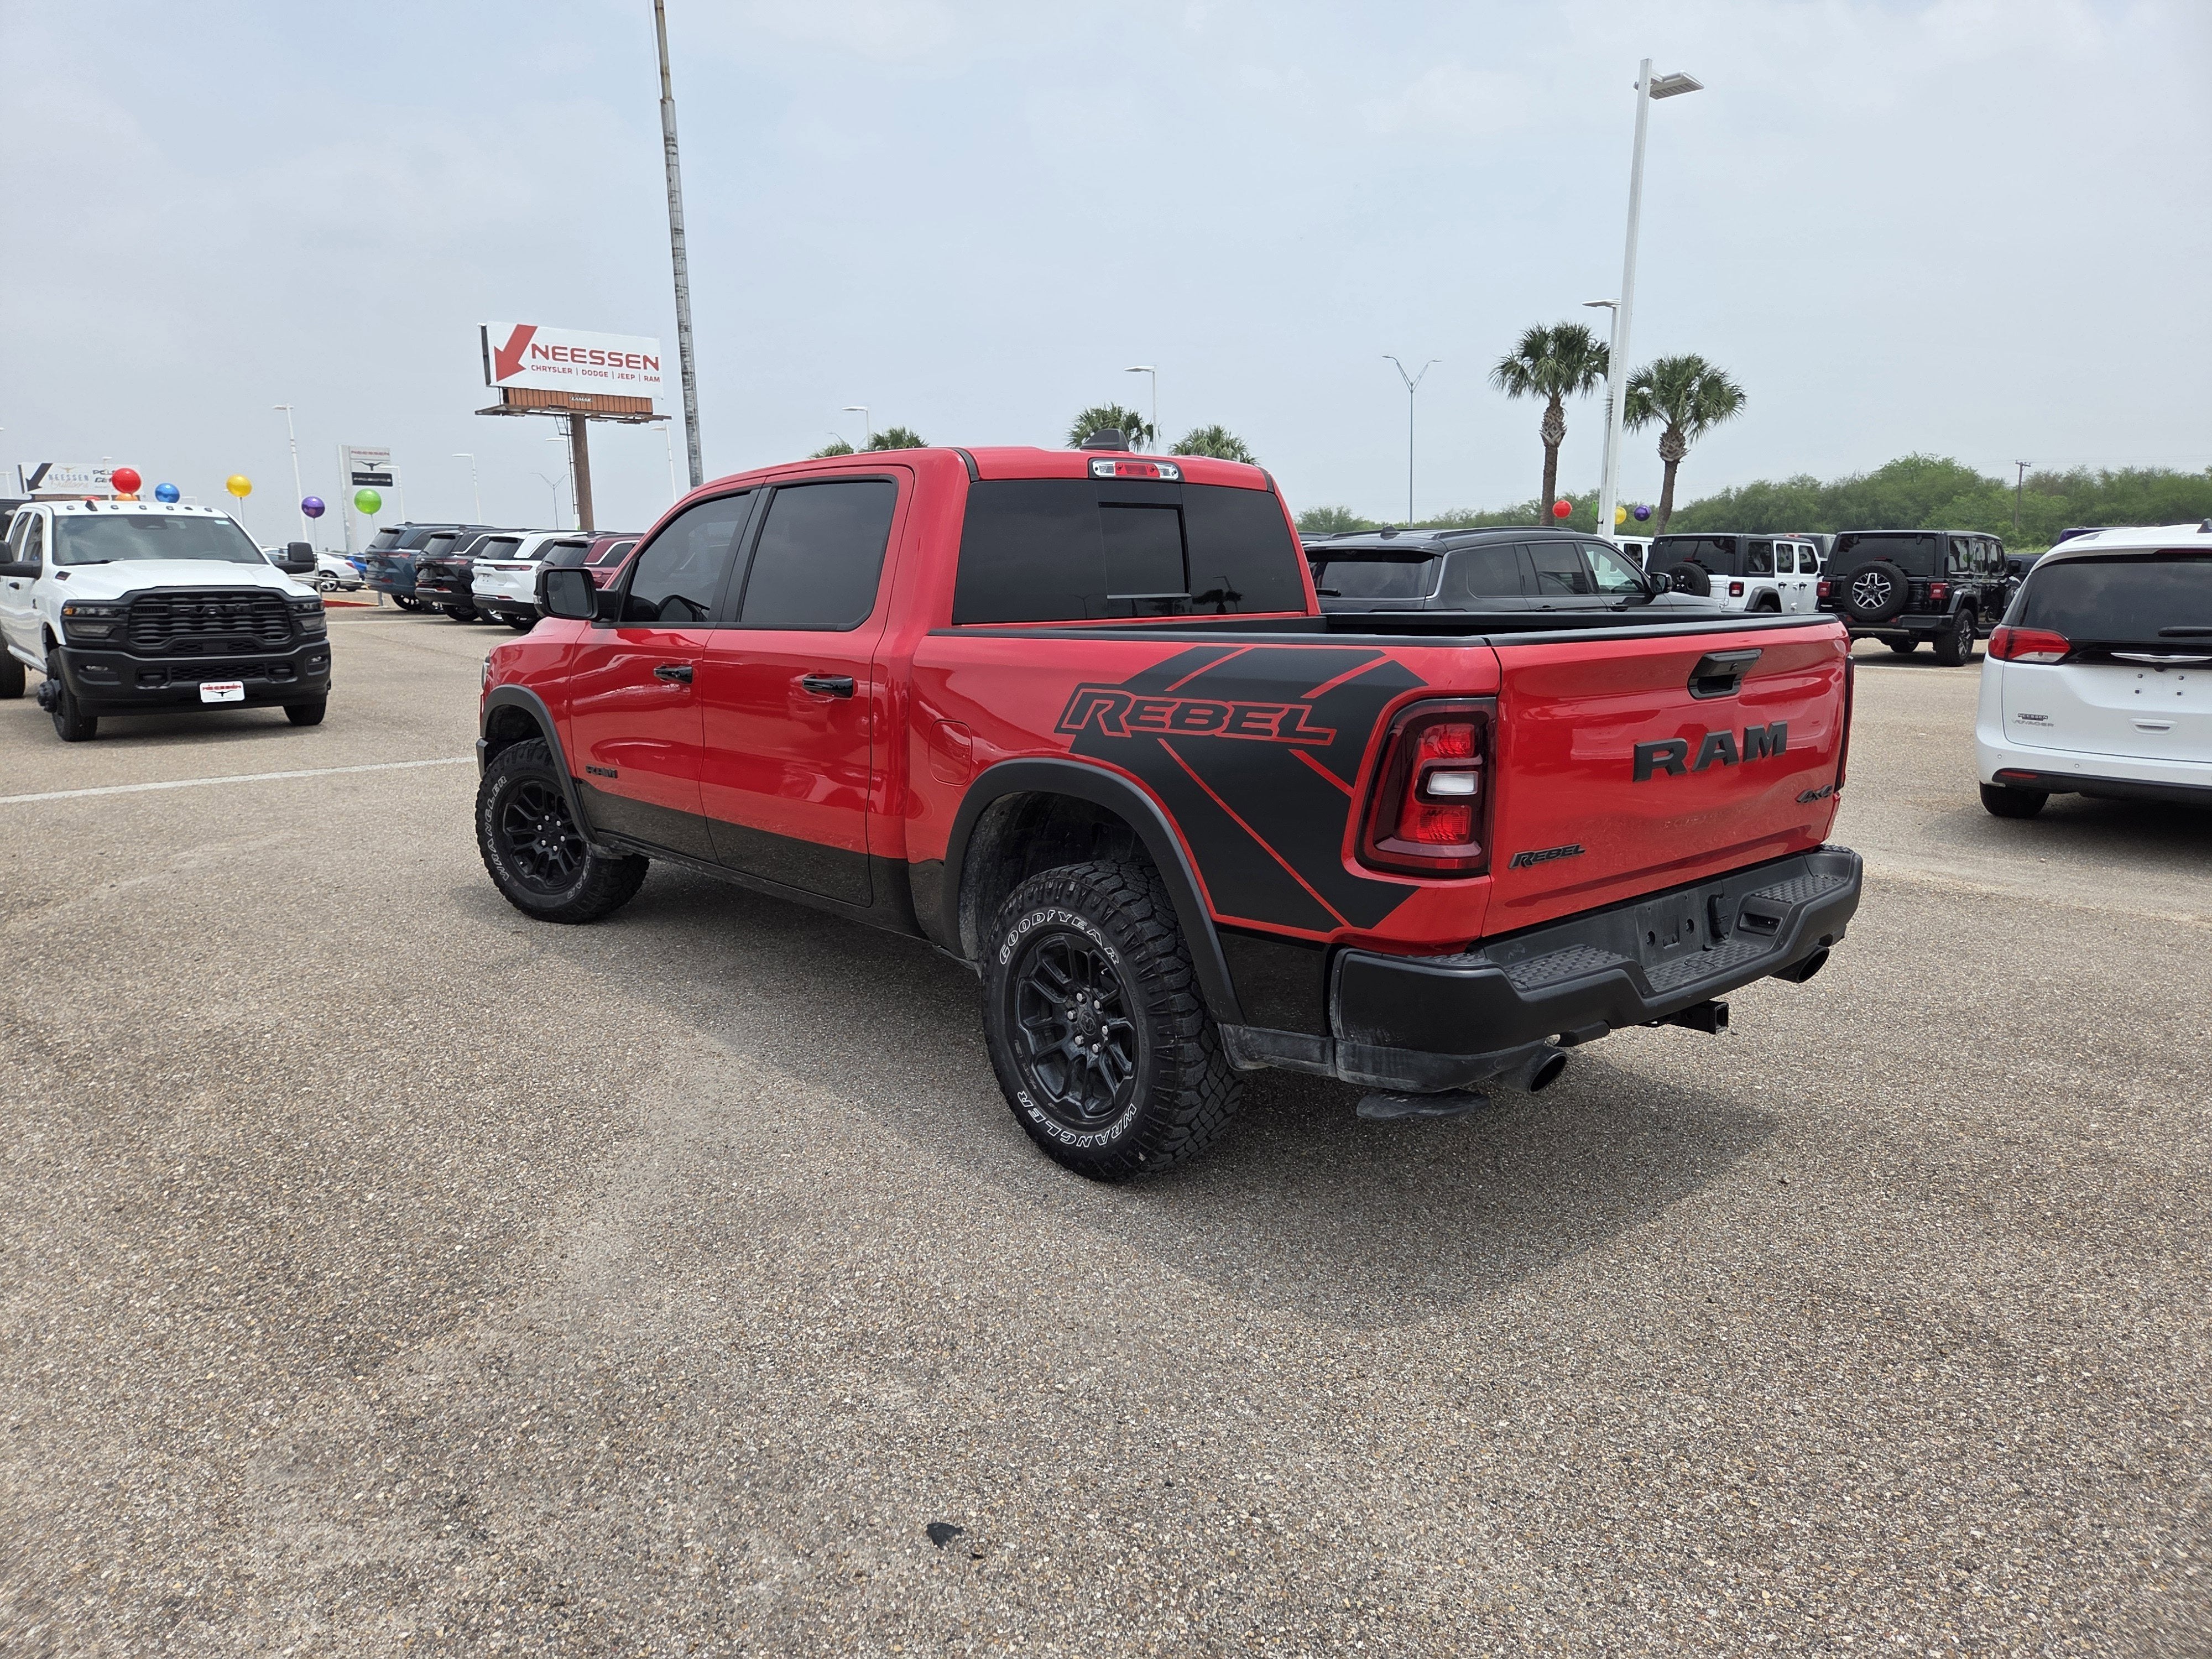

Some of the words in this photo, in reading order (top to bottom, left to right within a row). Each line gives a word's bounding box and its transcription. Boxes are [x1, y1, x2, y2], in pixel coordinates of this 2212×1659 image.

[531, 343, 659, 371] NEESSEN
[531, 364, 572, 374] CHRYSLER
[582, 369, 608, 378] DODGE
[1060, 688, 1337, 745] REBEL
[585, 765, 618, 779] RAM
[1632, 719, 1788, 782] RAM
[484, 775, 510, 881] WRANGLER
[1509, 843, 1585, 869] REBEL
[999, 909, 1120, 965] GOODYEAR
[1017, 1090, 1137, 1148] WRANGLER
